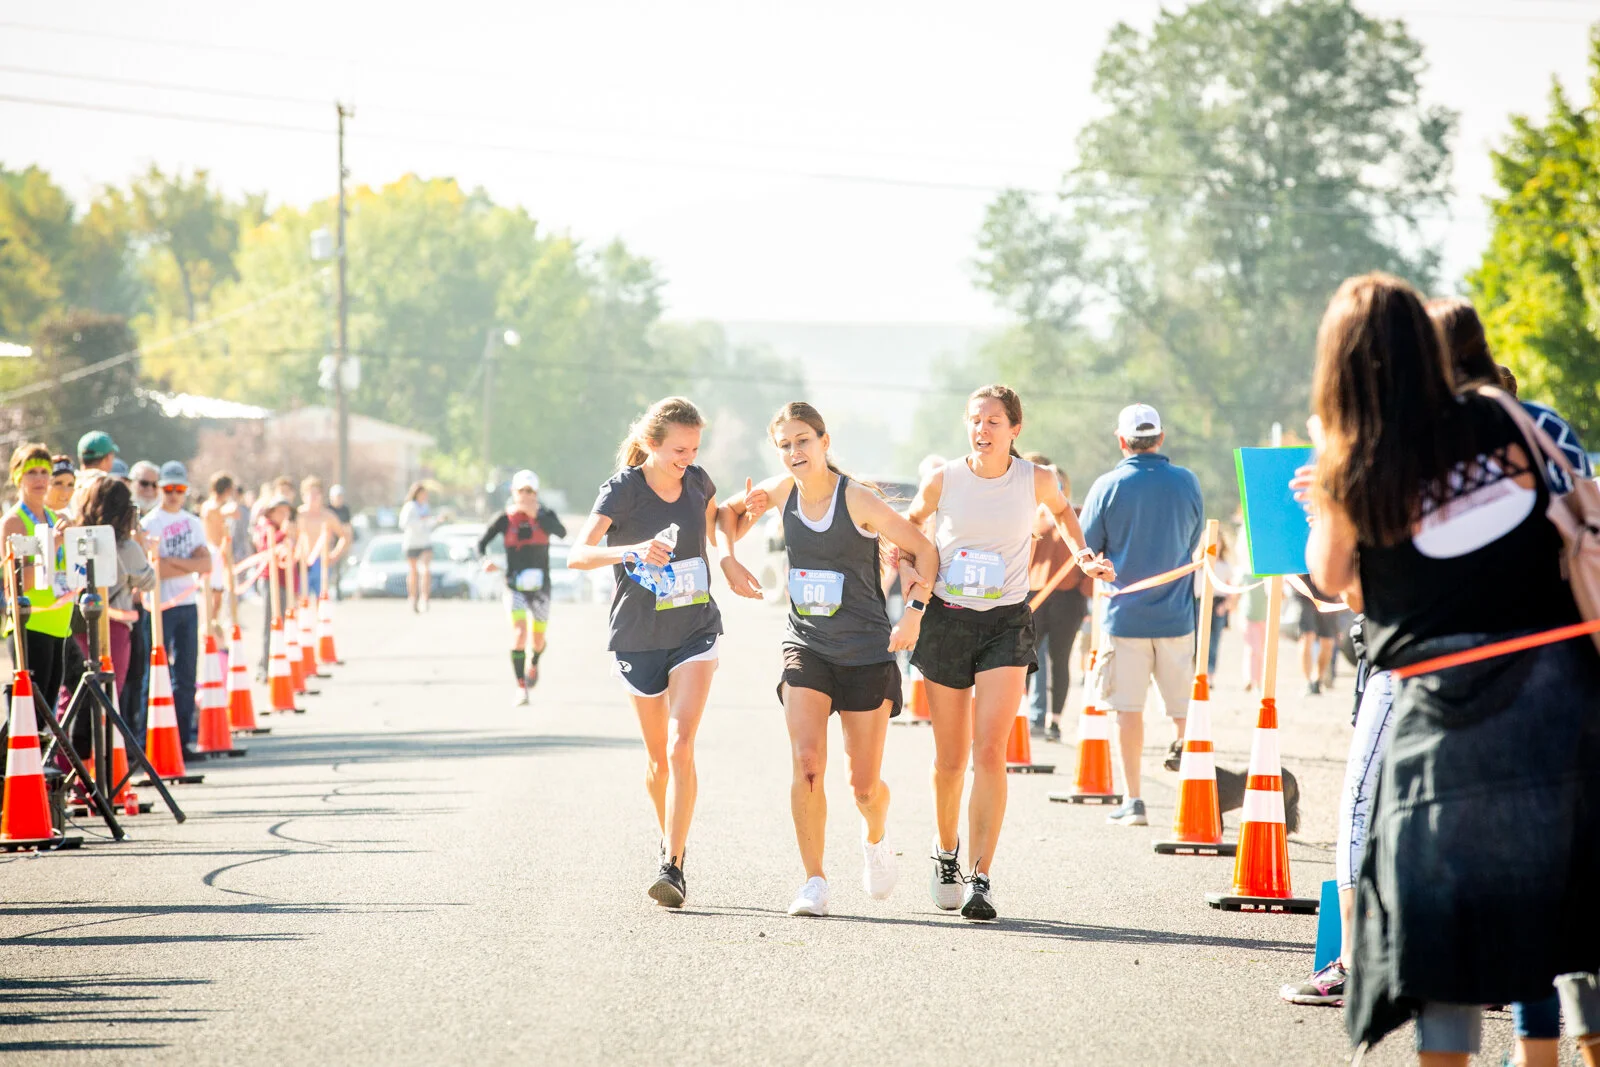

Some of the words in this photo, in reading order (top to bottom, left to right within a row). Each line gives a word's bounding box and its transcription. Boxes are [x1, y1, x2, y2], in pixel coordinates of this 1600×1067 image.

[673, 573, 695, 594] 43
[964, 565, 987, 585] 51
[803, 583, 825, 603] 60
